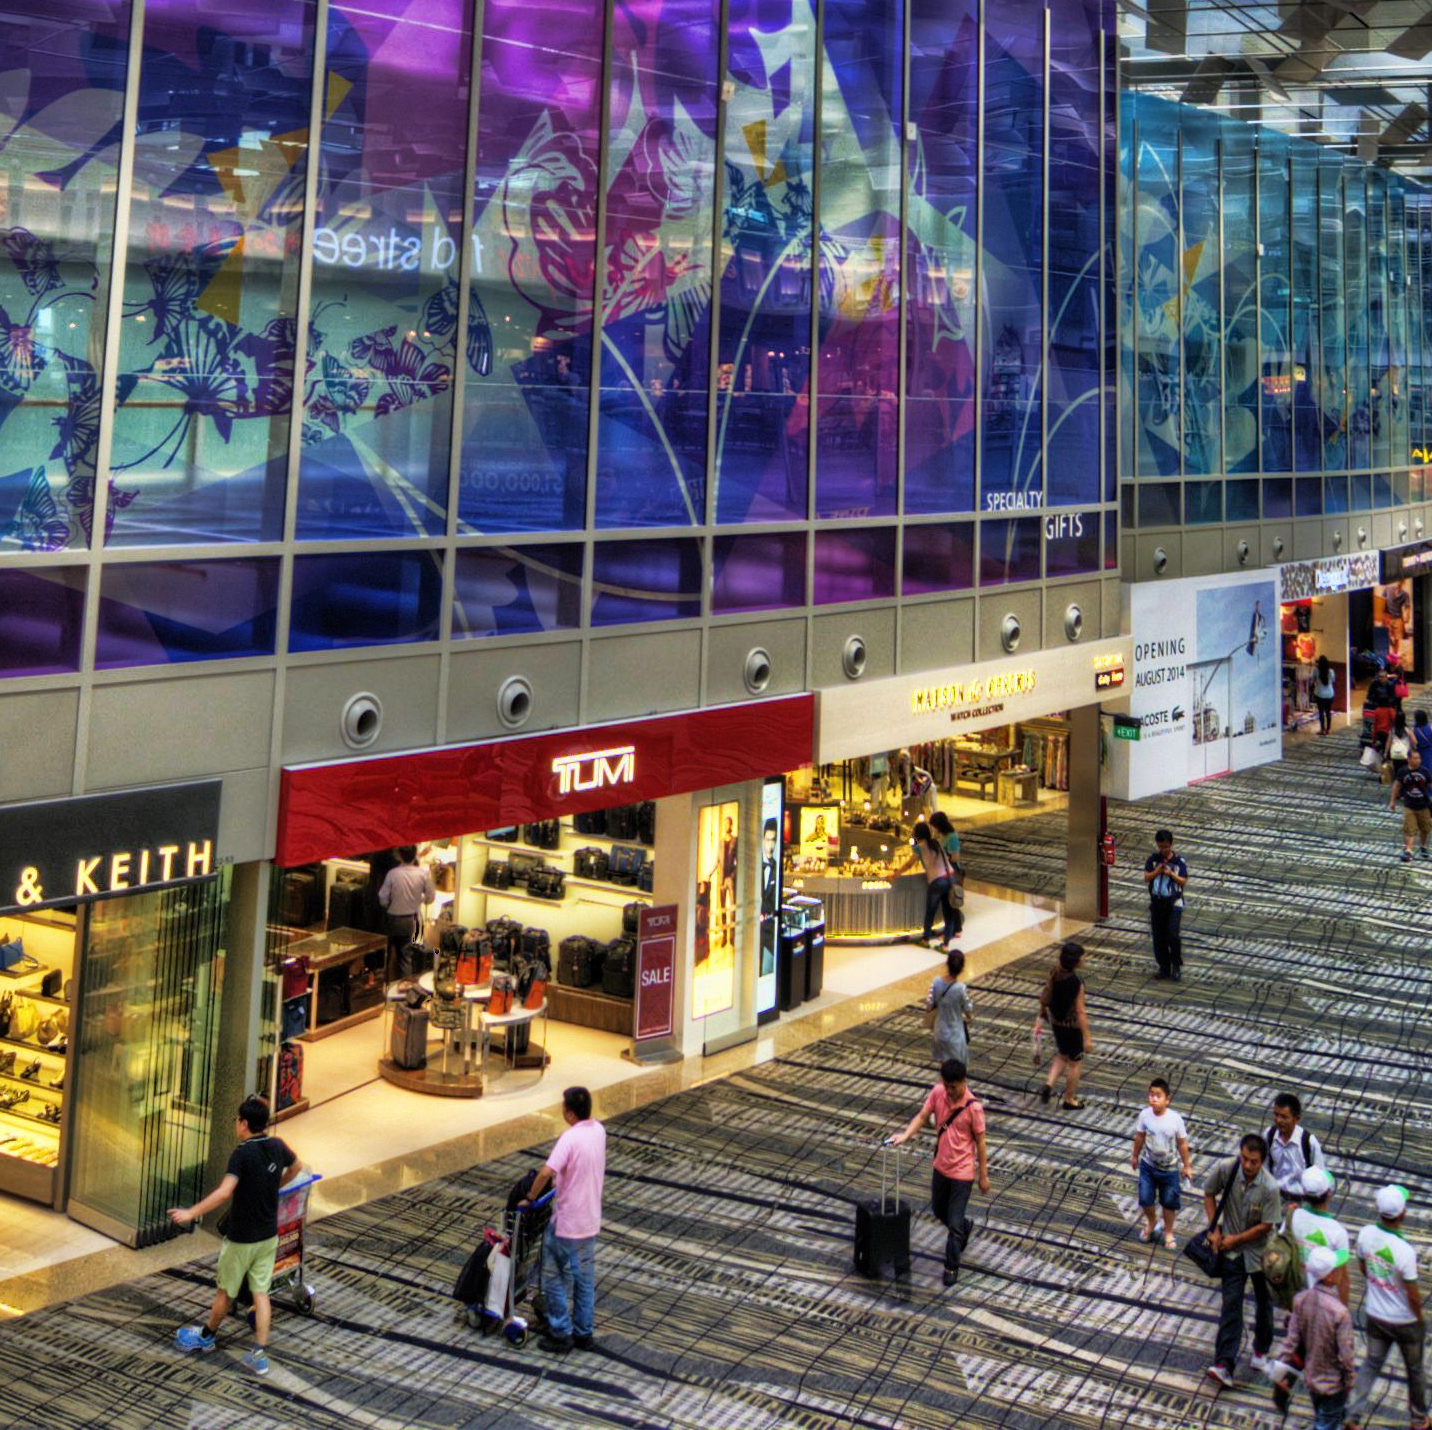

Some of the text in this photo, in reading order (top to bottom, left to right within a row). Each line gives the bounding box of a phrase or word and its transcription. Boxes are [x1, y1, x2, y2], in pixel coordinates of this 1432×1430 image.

[987, 491, 1043, 511] SPECIALTY
[1045, 513, 1083, 540] GIFTS
[1135, 638, 1186, 662] OPENING
[1135, 665, 1186, 688] AUGUST 2014
[1140, 710, 1169, 726] ACOSTE
[1121, 729, 1136, 740] EXIT
[552, 745, 635, 794] TUMI
[16, 865, 44, 906] &
[75, 839, 212, 896] KEITH
[641, 967, 671, 987] SALE
